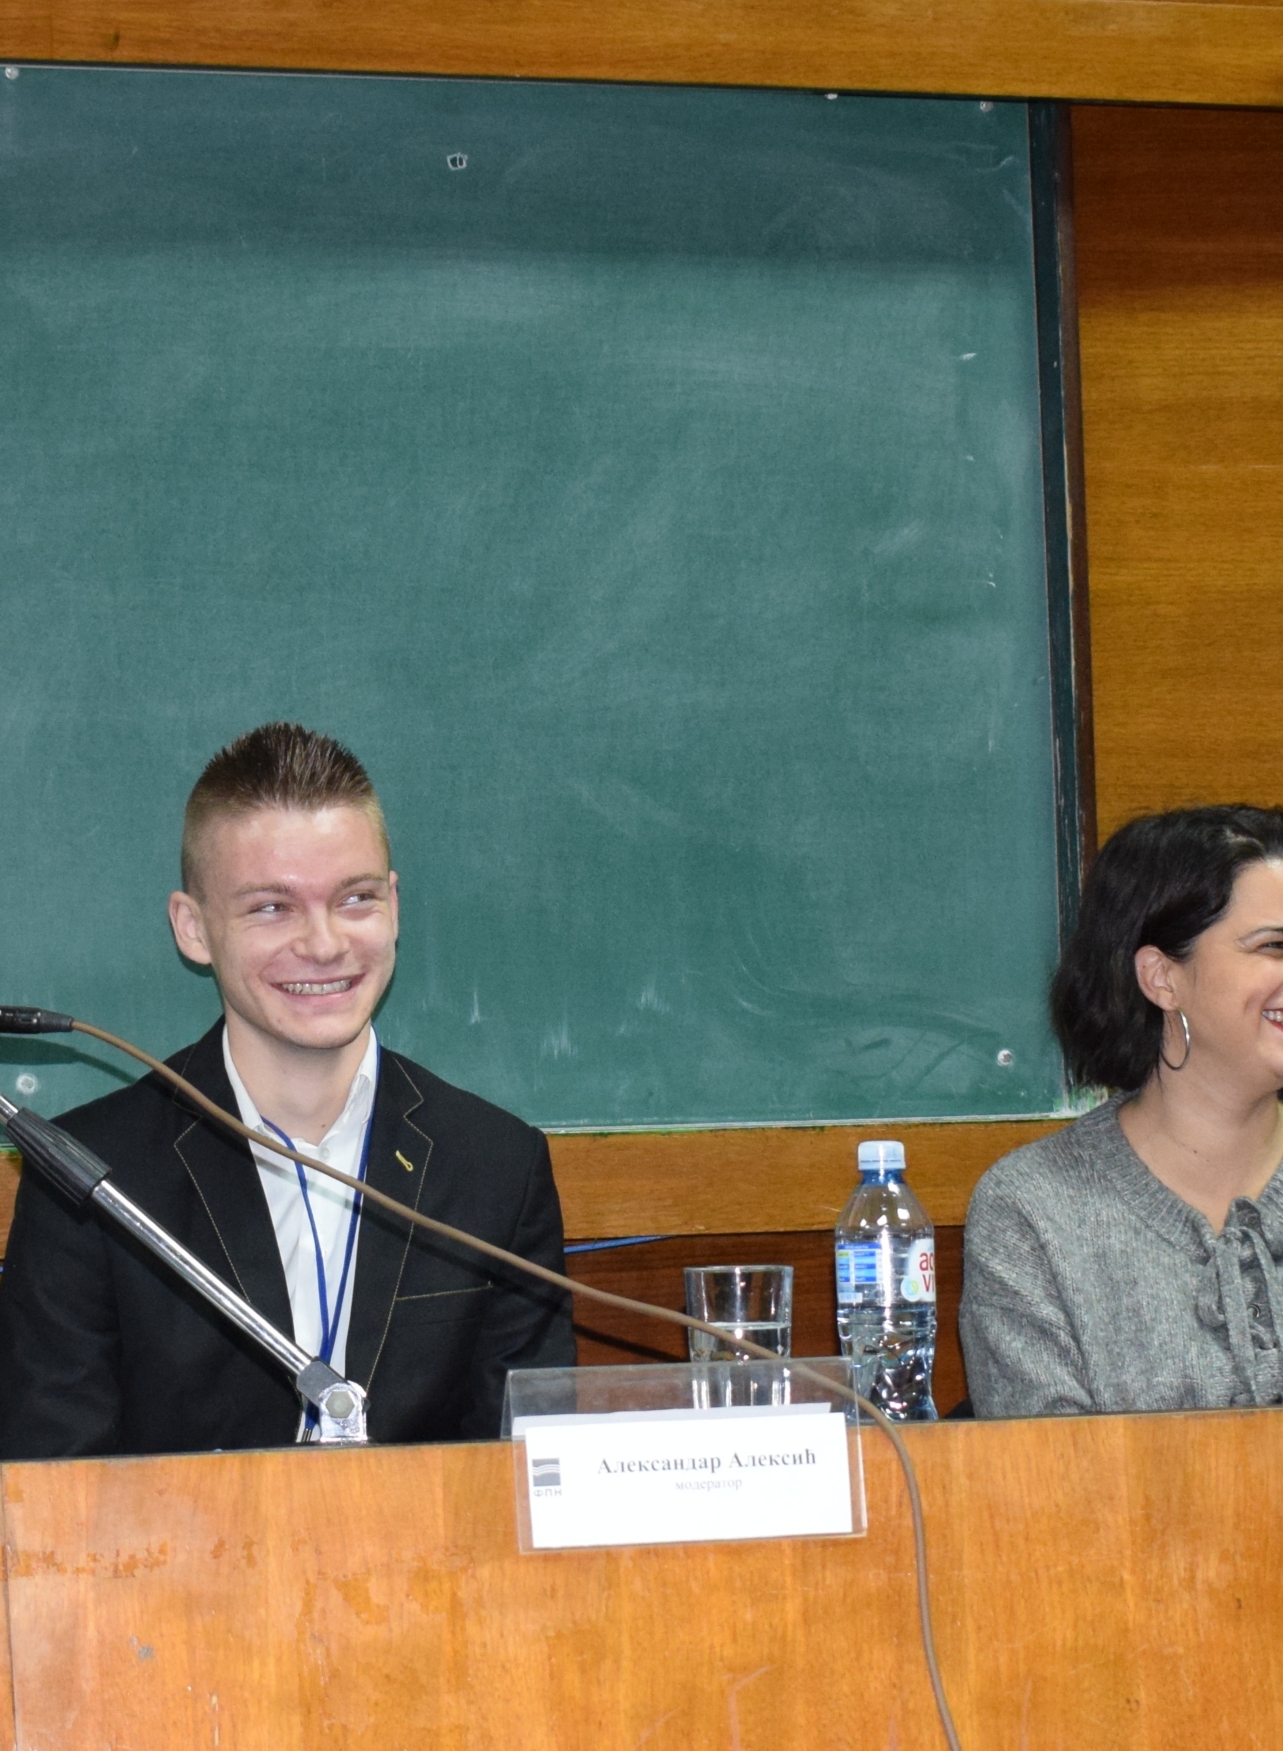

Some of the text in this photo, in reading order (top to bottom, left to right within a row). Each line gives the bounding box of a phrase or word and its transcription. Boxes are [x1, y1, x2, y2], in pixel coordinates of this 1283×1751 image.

[597, 1448, 816, 1475] Александар Алексић
[675, 1477, 743, 1491] модератор
[533, 1488, 562, 1498] ФПН
